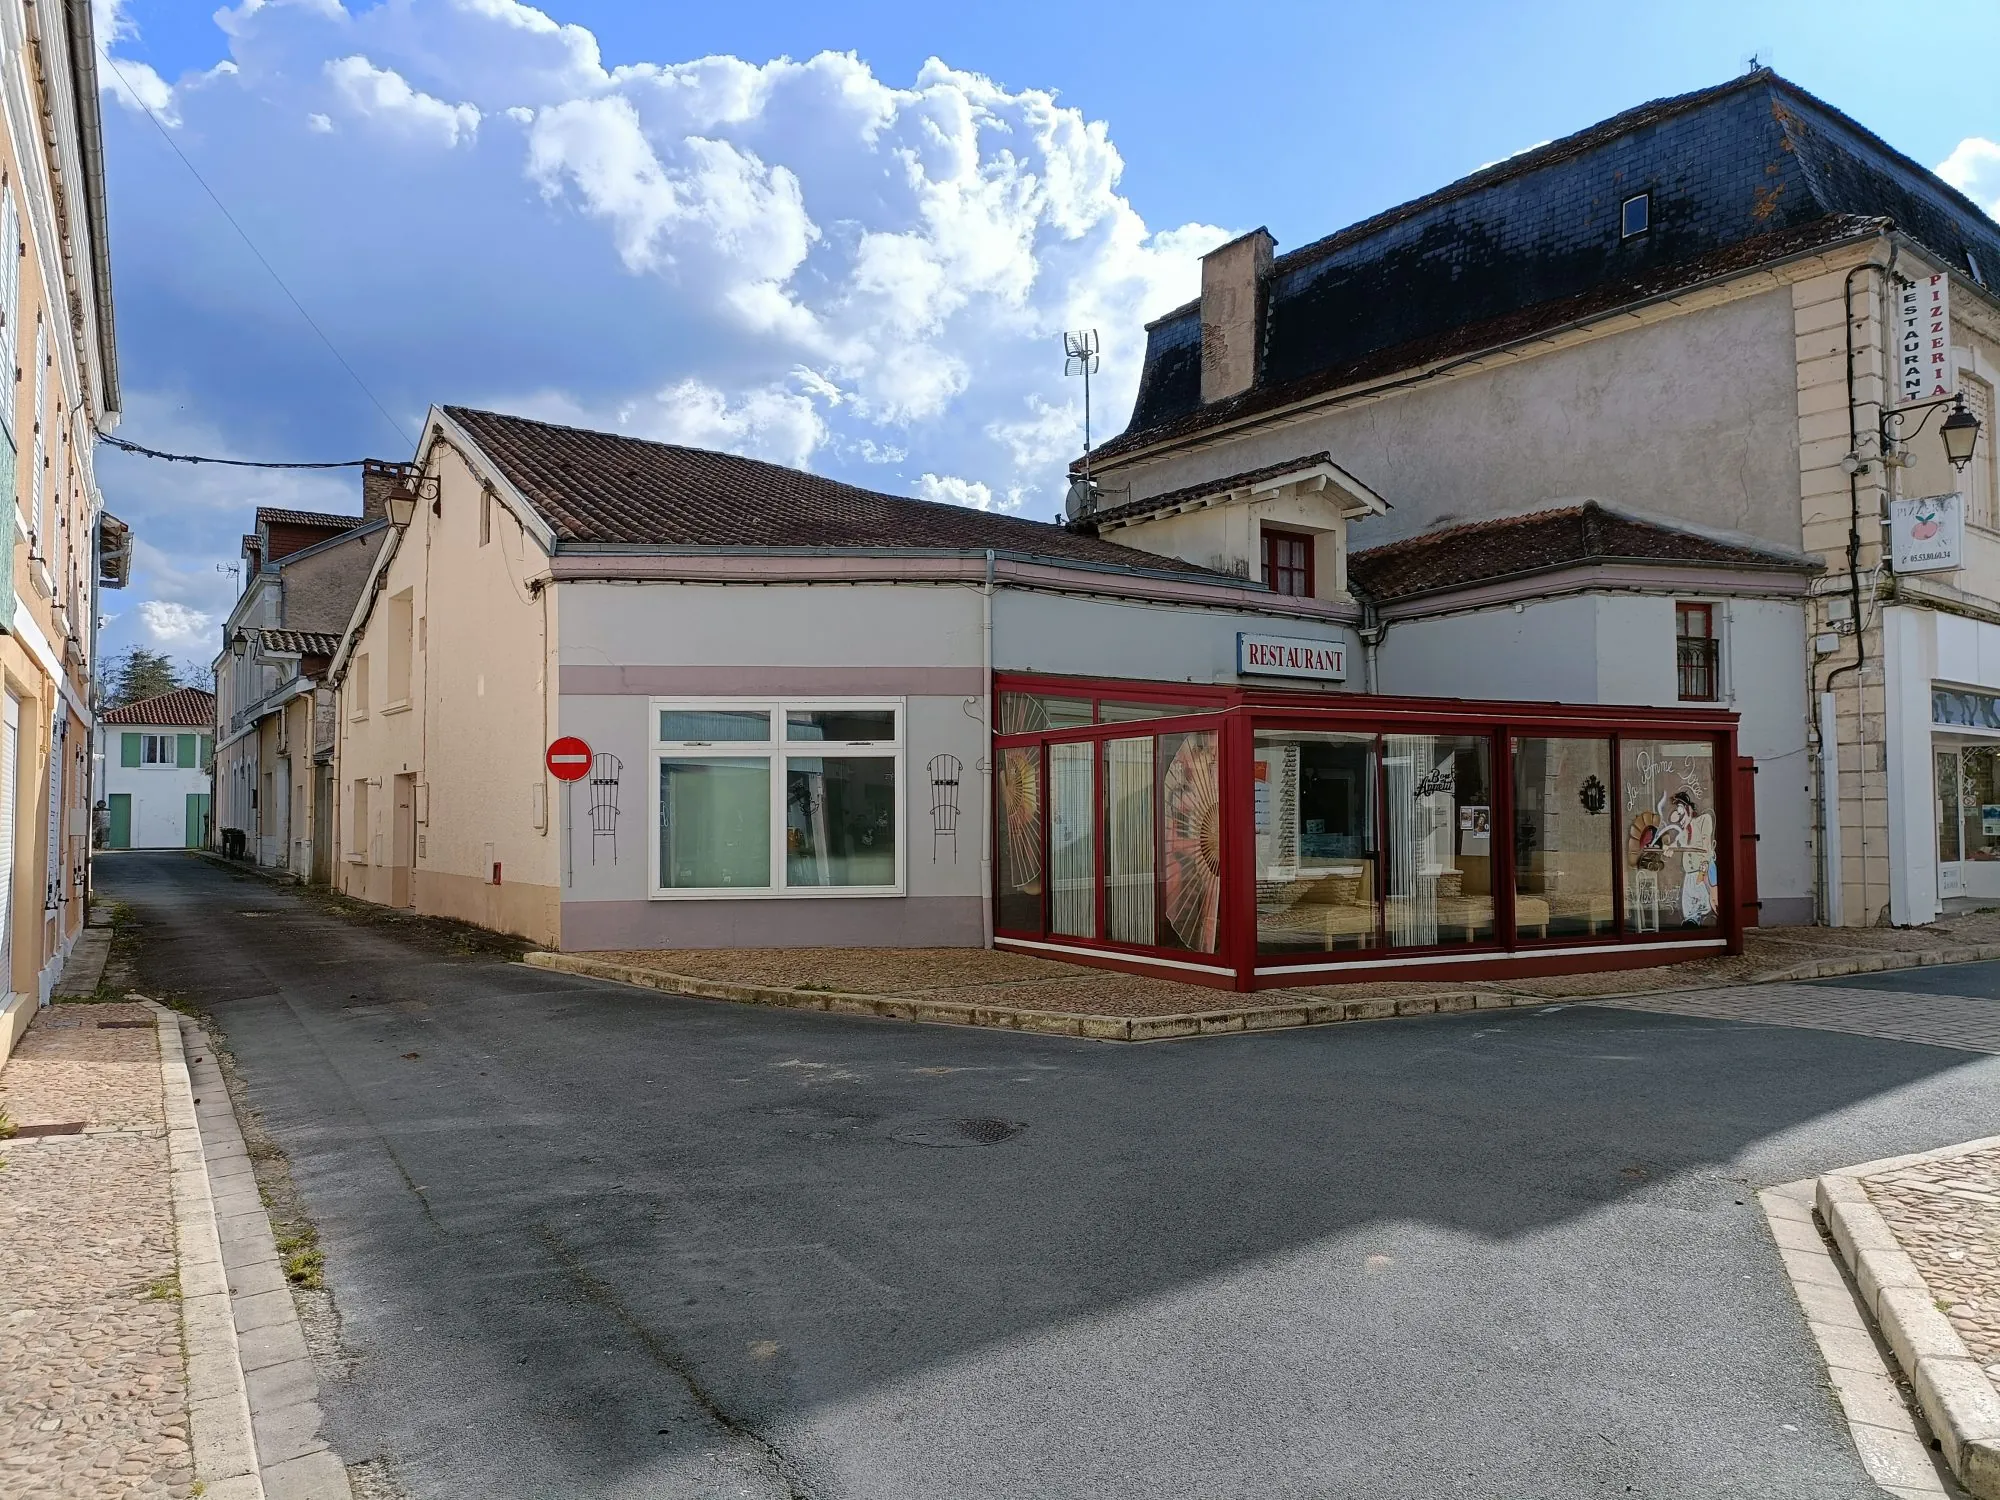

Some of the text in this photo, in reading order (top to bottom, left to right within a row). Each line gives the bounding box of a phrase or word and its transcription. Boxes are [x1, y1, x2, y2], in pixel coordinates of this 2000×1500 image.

[1902, 281, 1921, 401] RESTAURANT
[1930, 274, 1946, 396] PIZZERIA
[1249, 643, 1343, 672] RESTAURANT
